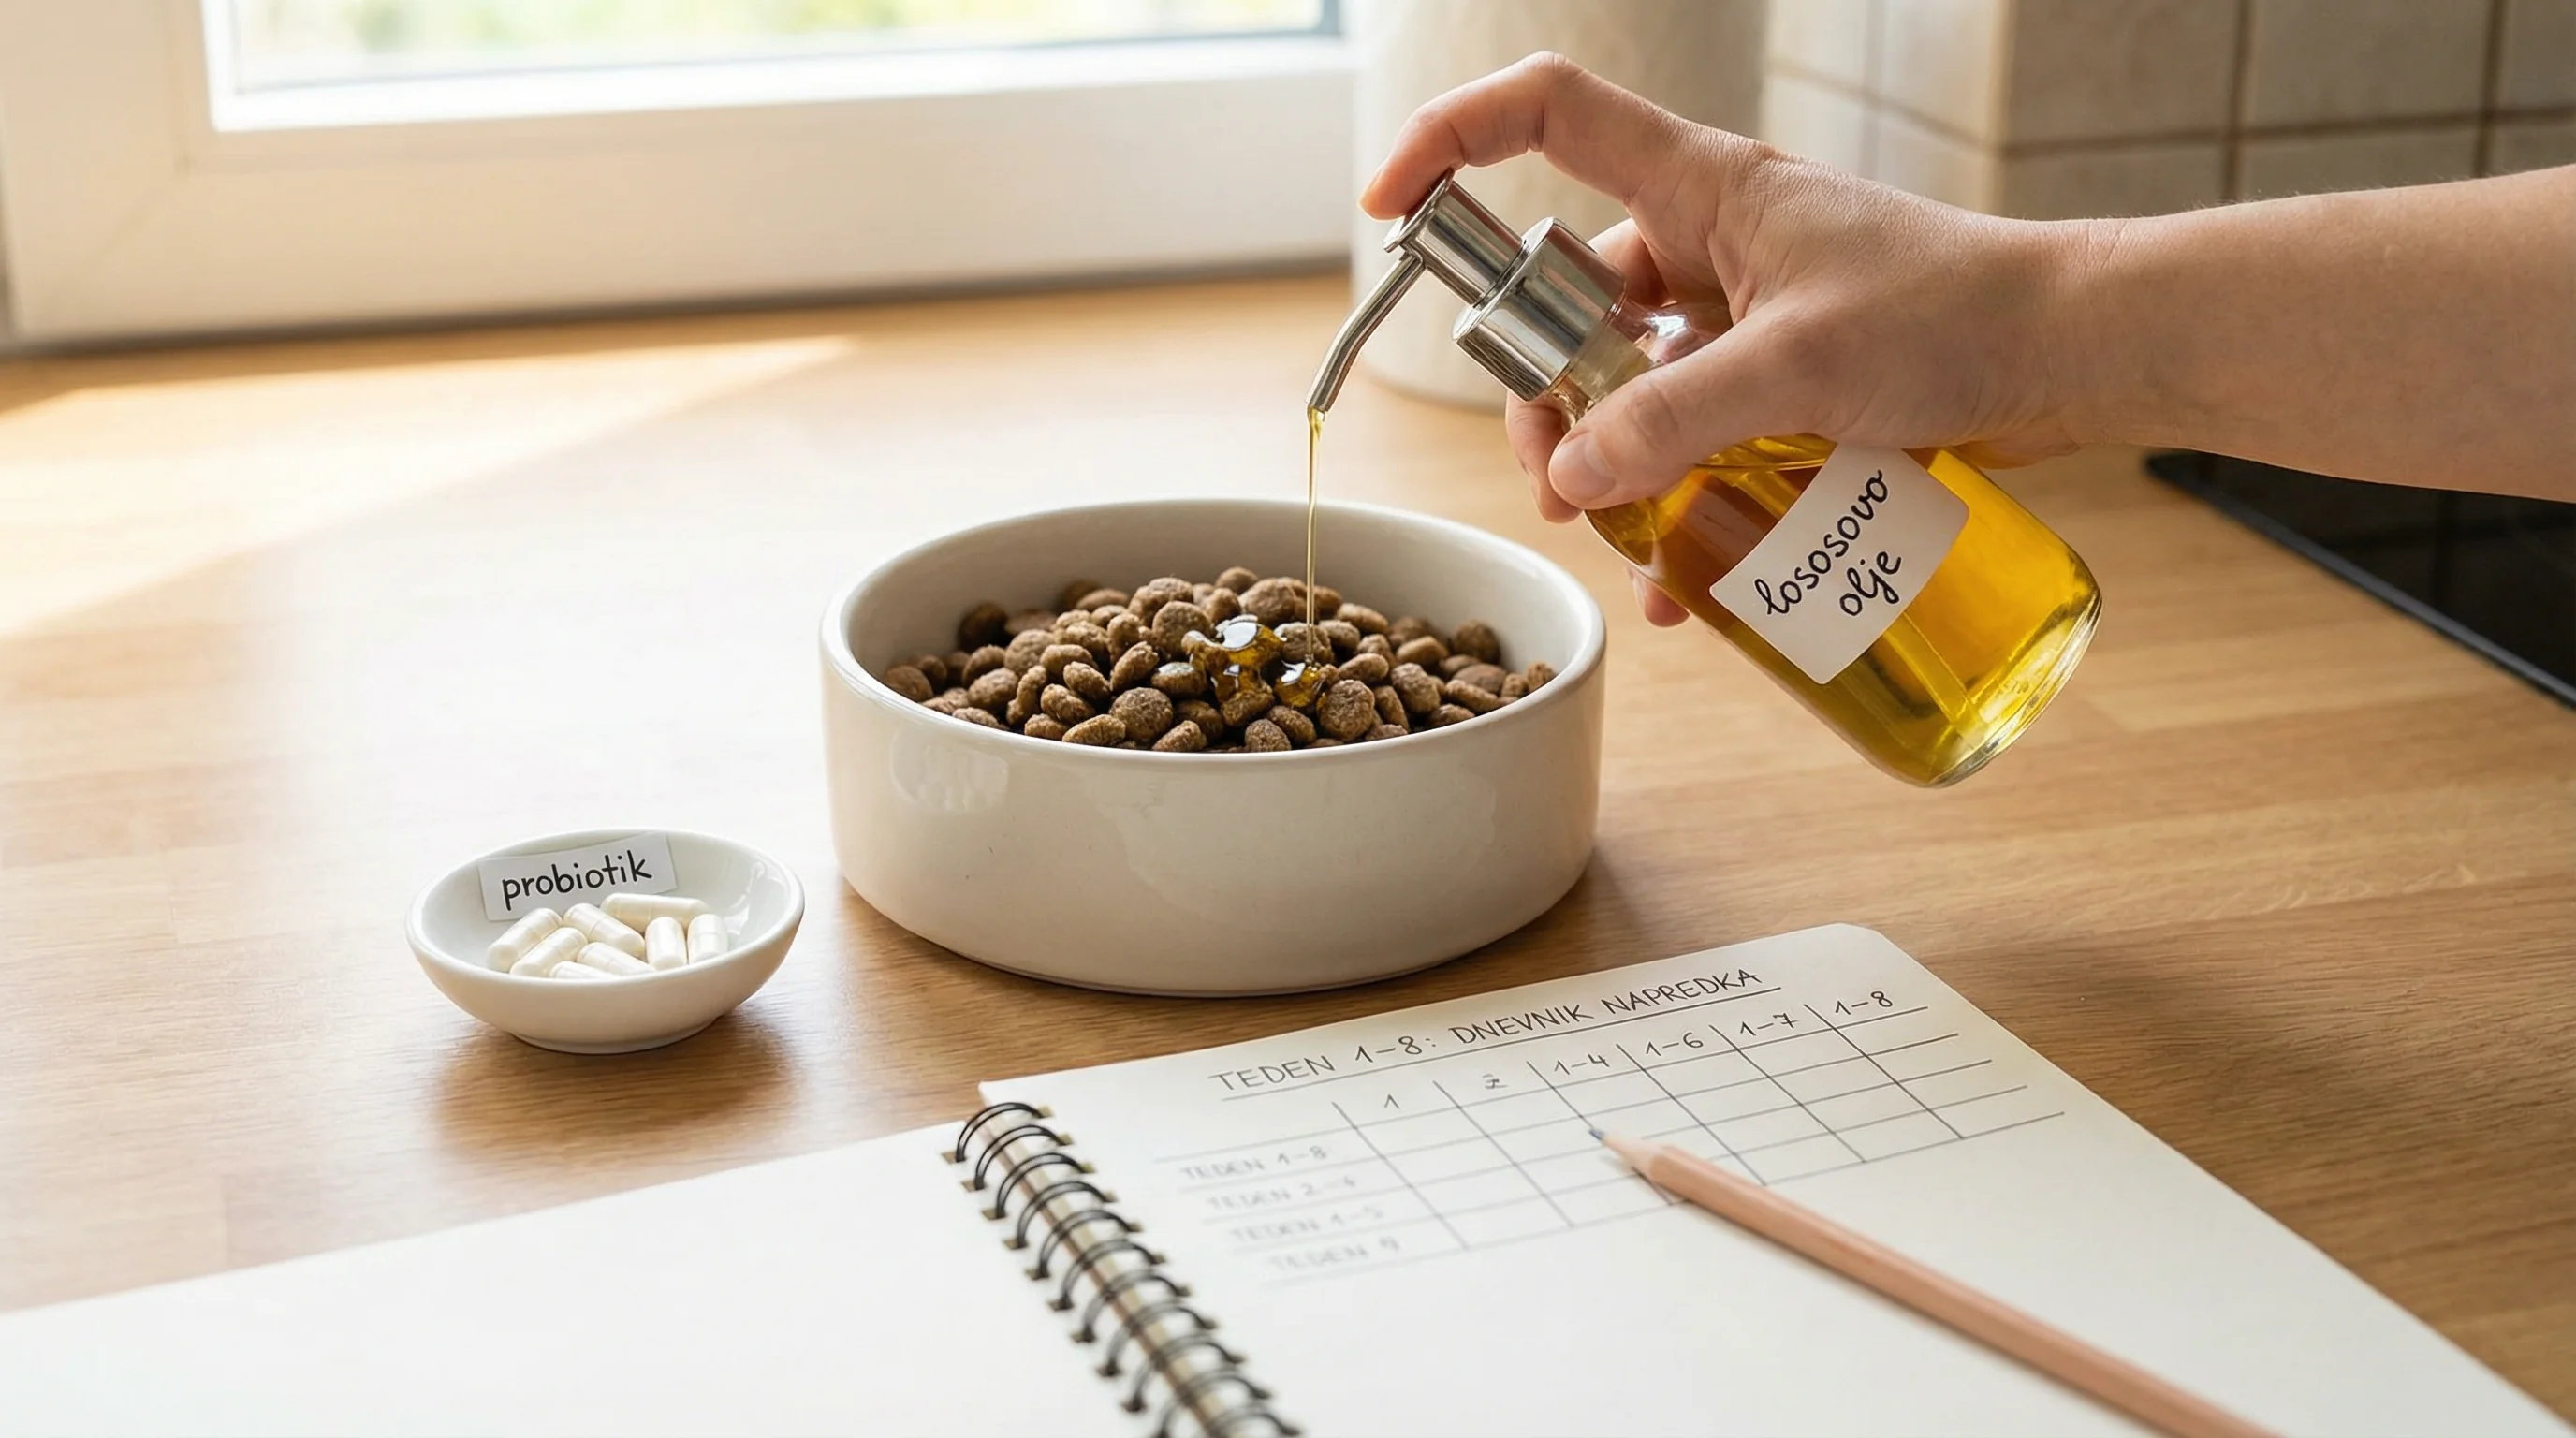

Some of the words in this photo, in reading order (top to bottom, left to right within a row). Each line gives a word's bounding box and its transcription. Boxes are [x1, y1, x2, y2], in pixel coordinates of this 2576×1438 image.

[1754, 469, 1889, 616] lososovo
[1838, 550, 1903, 617] olje
[501, 849, 653, 912] probiotik
[1207, 1054, 1336, 1092] TEDEN
[1447, 1003, 1595, 1045] DNEVNIK
[1601, 967, 1764, 1016] NAPREDKA
[1645, 1031, 1705, 1058] 1-6
[1738, 1011, 1799, 1037] 1-7
[1834, 990, 1895, 1017] 1-8
